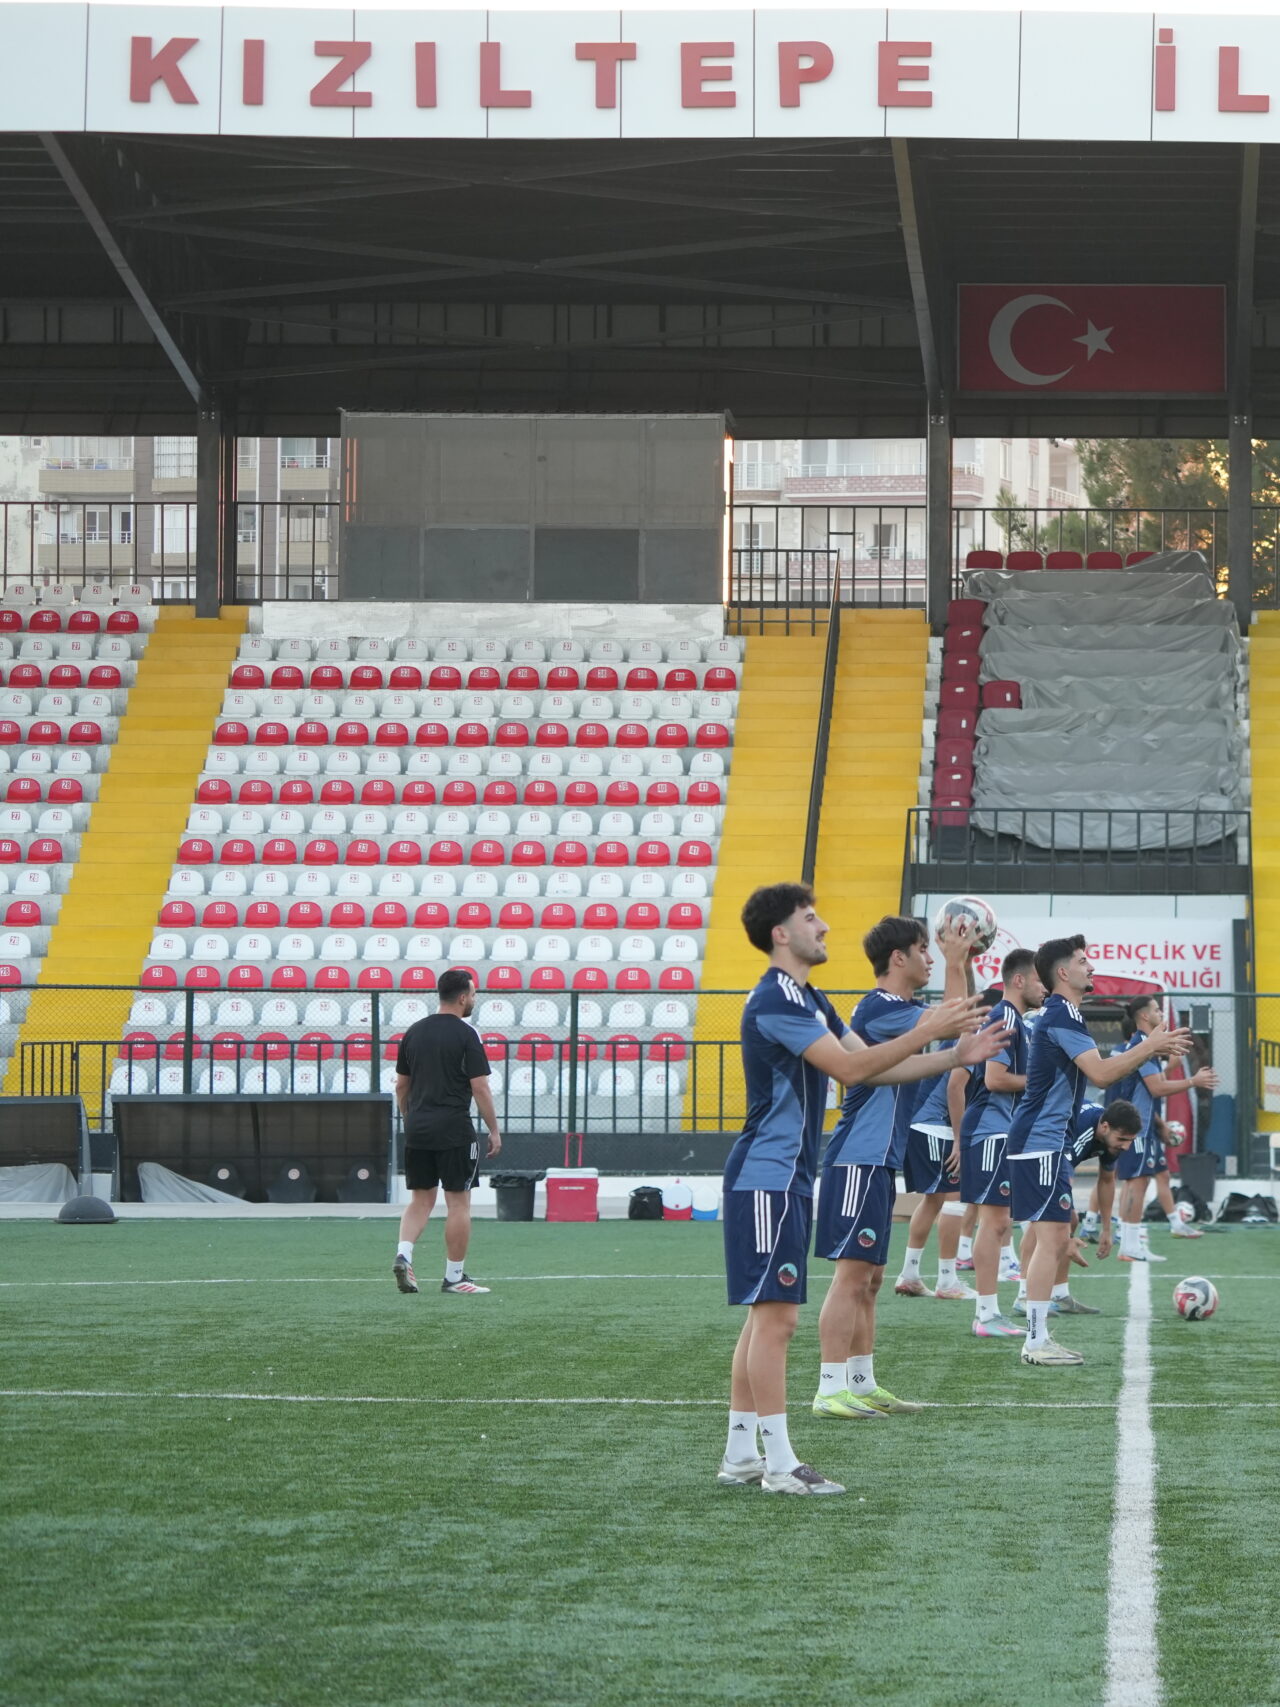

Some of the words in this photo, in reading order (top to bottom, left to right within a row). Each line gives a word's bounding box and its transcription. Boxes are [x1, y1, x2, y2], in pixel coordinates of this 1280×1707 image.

[129, 36, 933, 108] KIZILTEPE
[1085, 941, 1186, 964] GENÇLİK
[1192, 944, 1221, 960] VE
